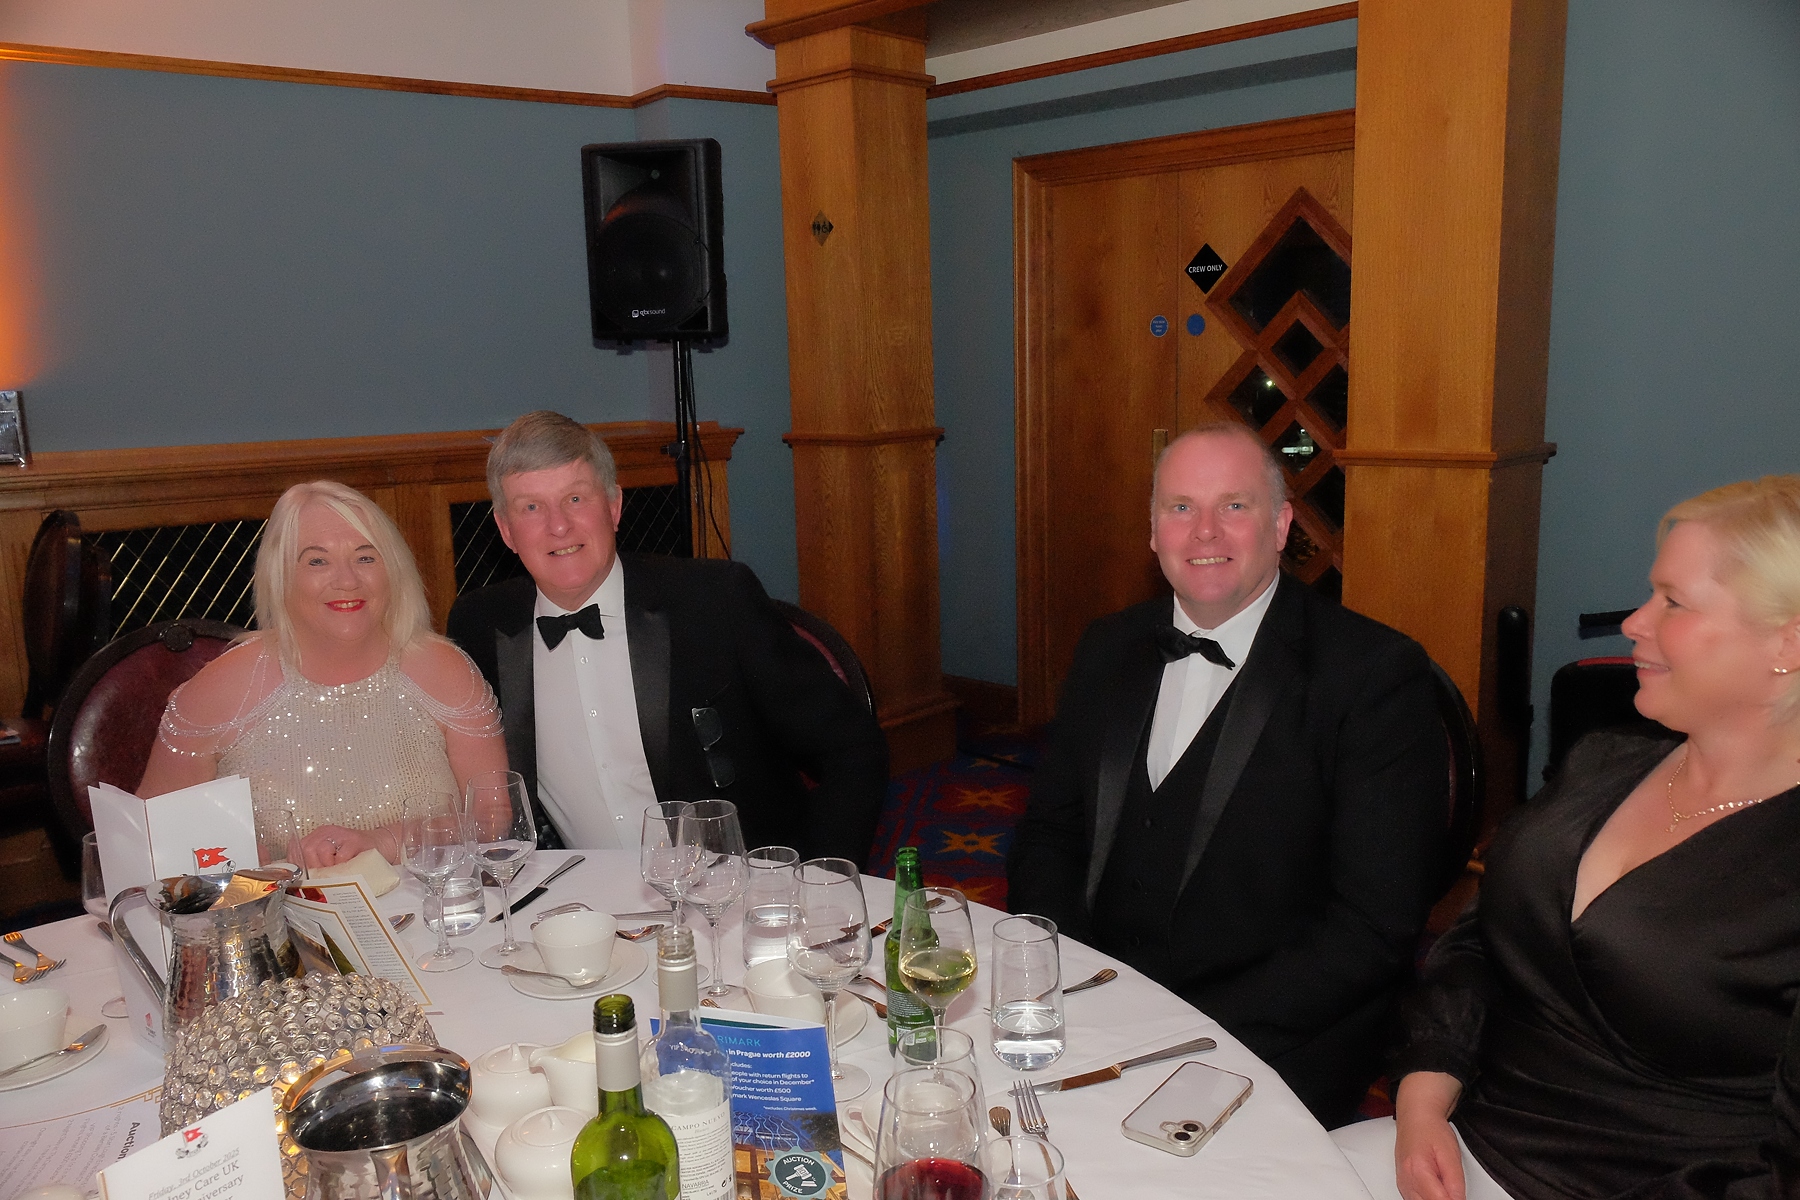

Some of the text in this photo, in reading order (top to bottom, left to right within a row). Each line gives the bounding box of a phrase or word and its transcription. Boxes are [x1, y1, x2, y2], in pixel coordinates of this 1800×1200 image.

[1206, 264, 1223, 272] ONLY
[716, 1035, 761, 1047] RIMARK
[736, 1049, 761, 1059] Prague
[785, 1051, 811, 1059] £2000
[671, 1122, 700, 1131] CAMPO
[117, 1121, 141, 1159] Auction
[192, 1158, 221, 1179] October
[222, 1147, 240, 1163] 2025
[783, 1156, 815, 1166] AUCTION
[168, 1159, 240, 1200] ney Care UK
[198, 1174, 244, 1200] iversary
[782, 1180, 803, 1194] PRIZE
